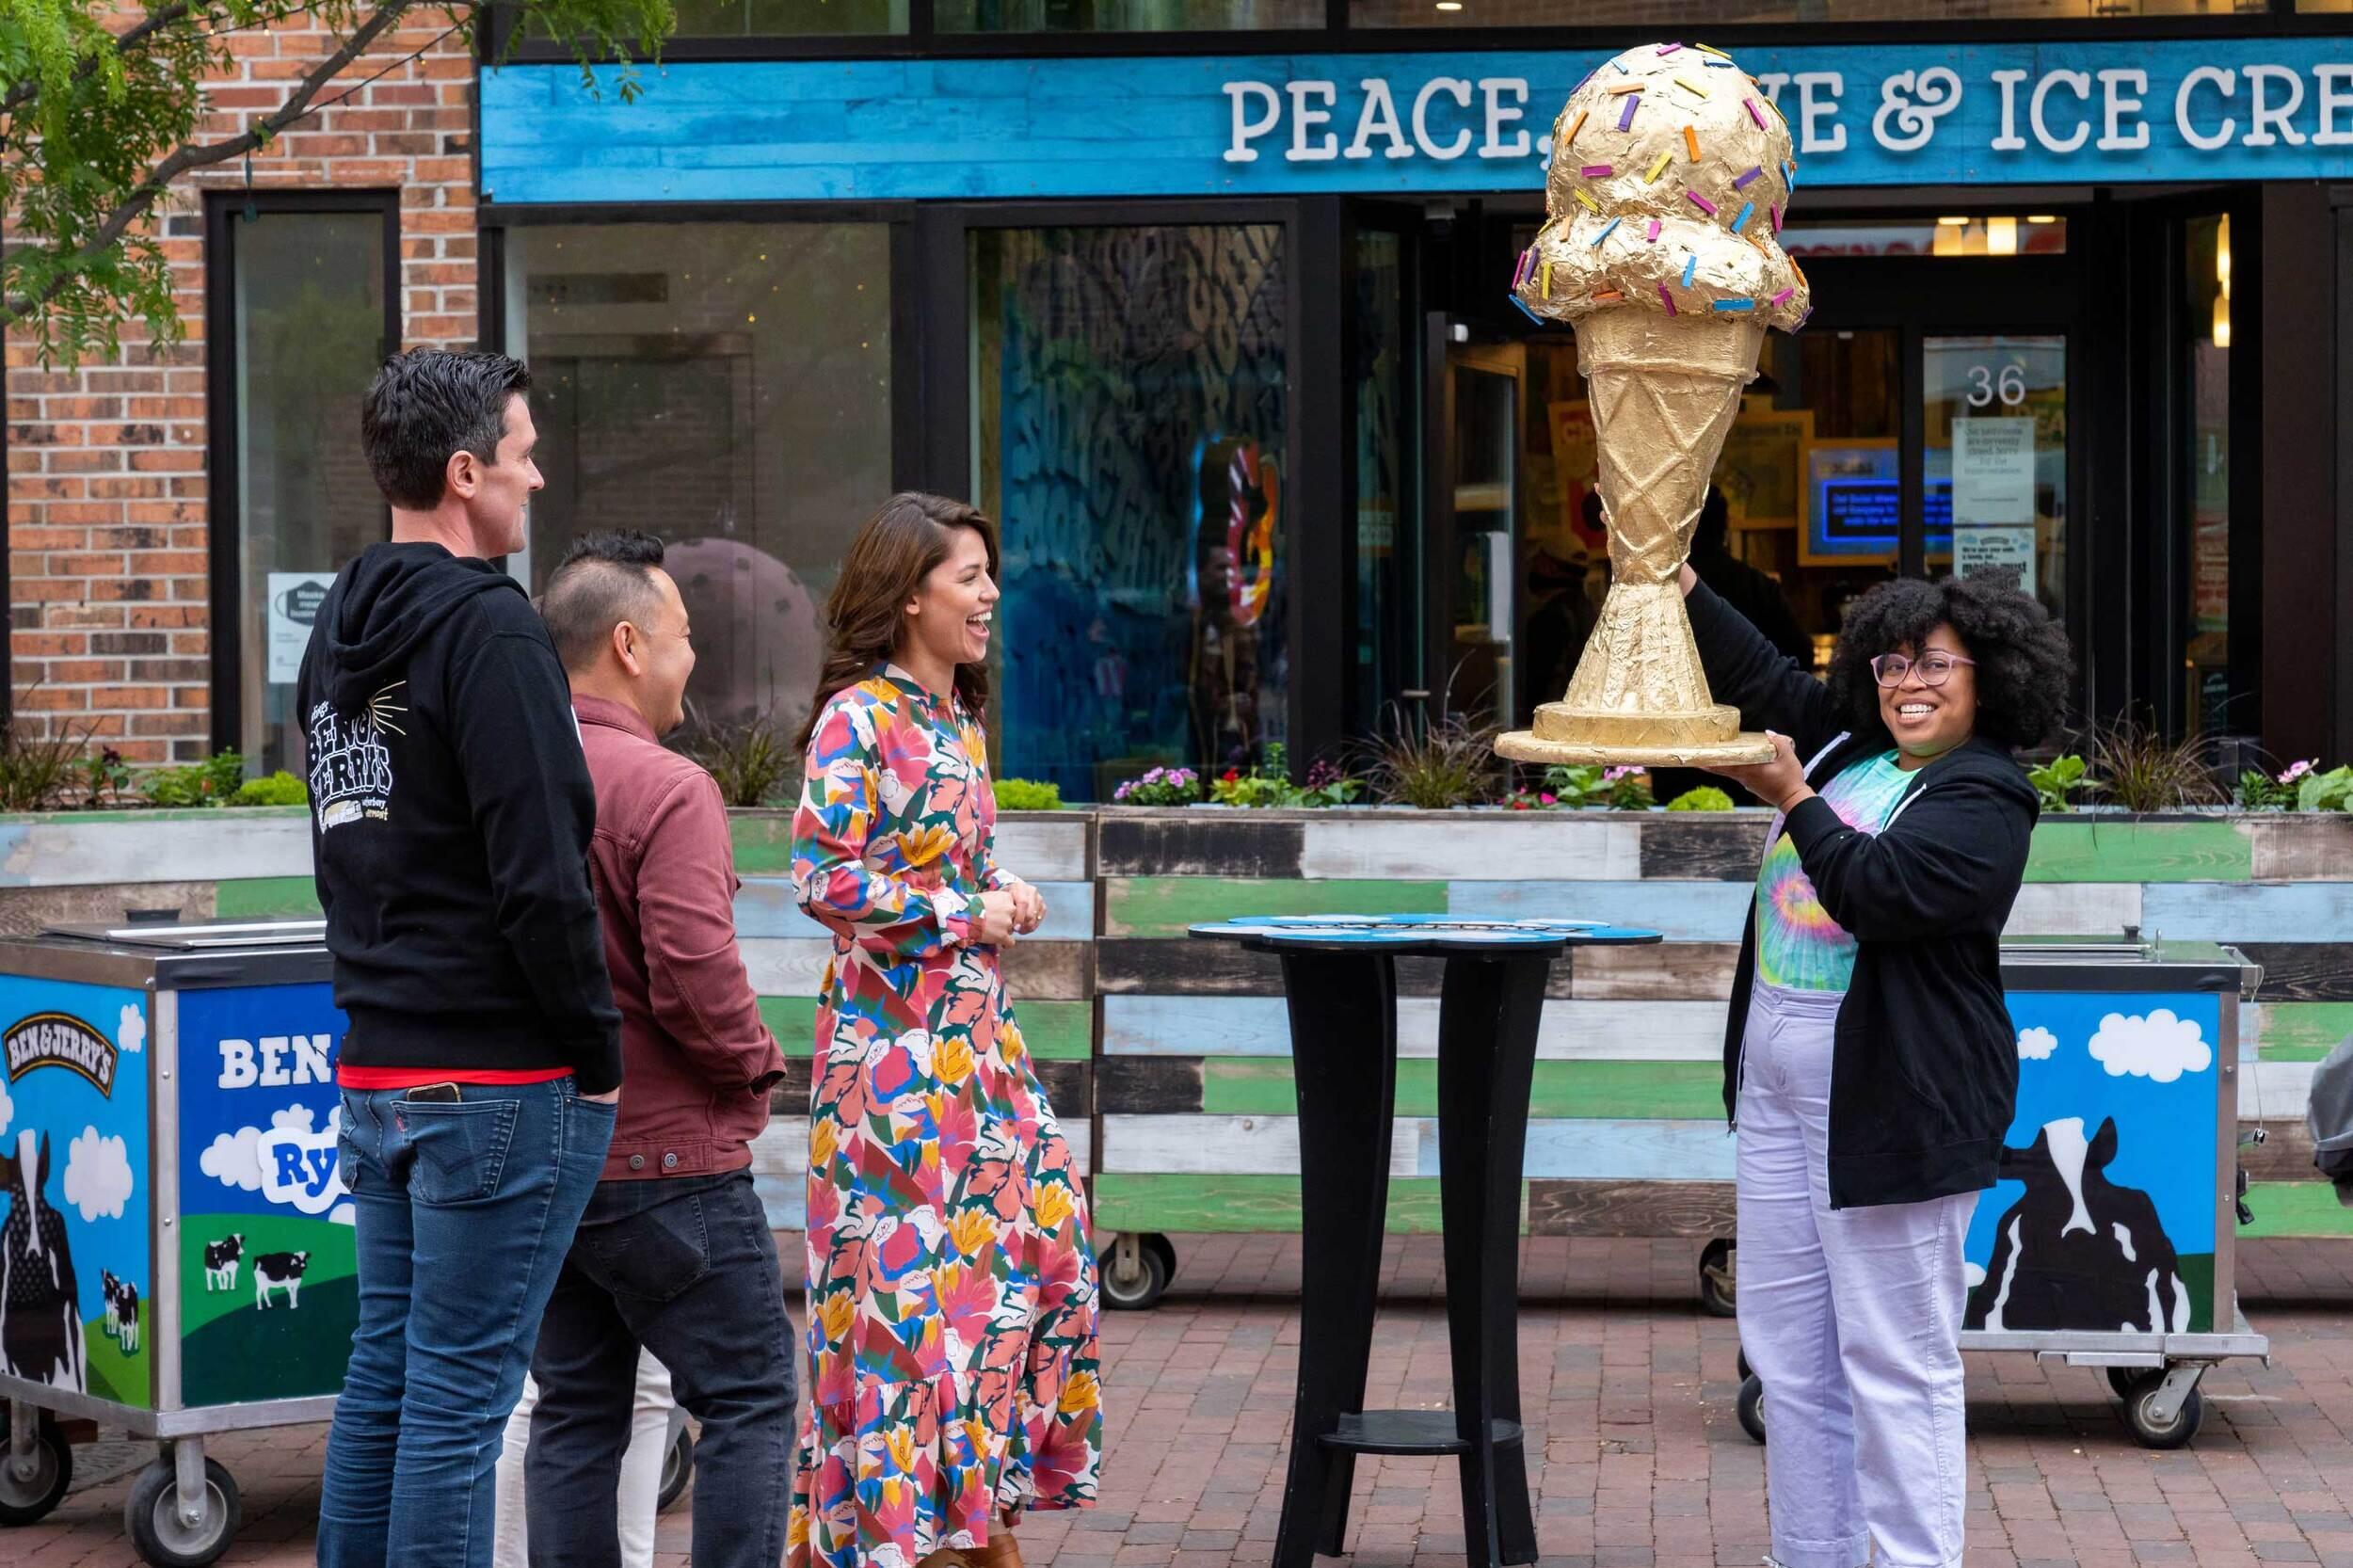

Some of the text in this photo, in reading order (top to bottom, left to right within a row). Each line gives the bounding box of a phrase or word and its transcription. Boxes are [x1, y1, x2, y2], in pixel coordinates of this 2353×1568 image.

[1872, 67, 1962, 152] &
[1991, 69, 2150, 152] ICE
[1966, 365, 2025, 407] 36
[218, 1033, 331, 1089] BEN
